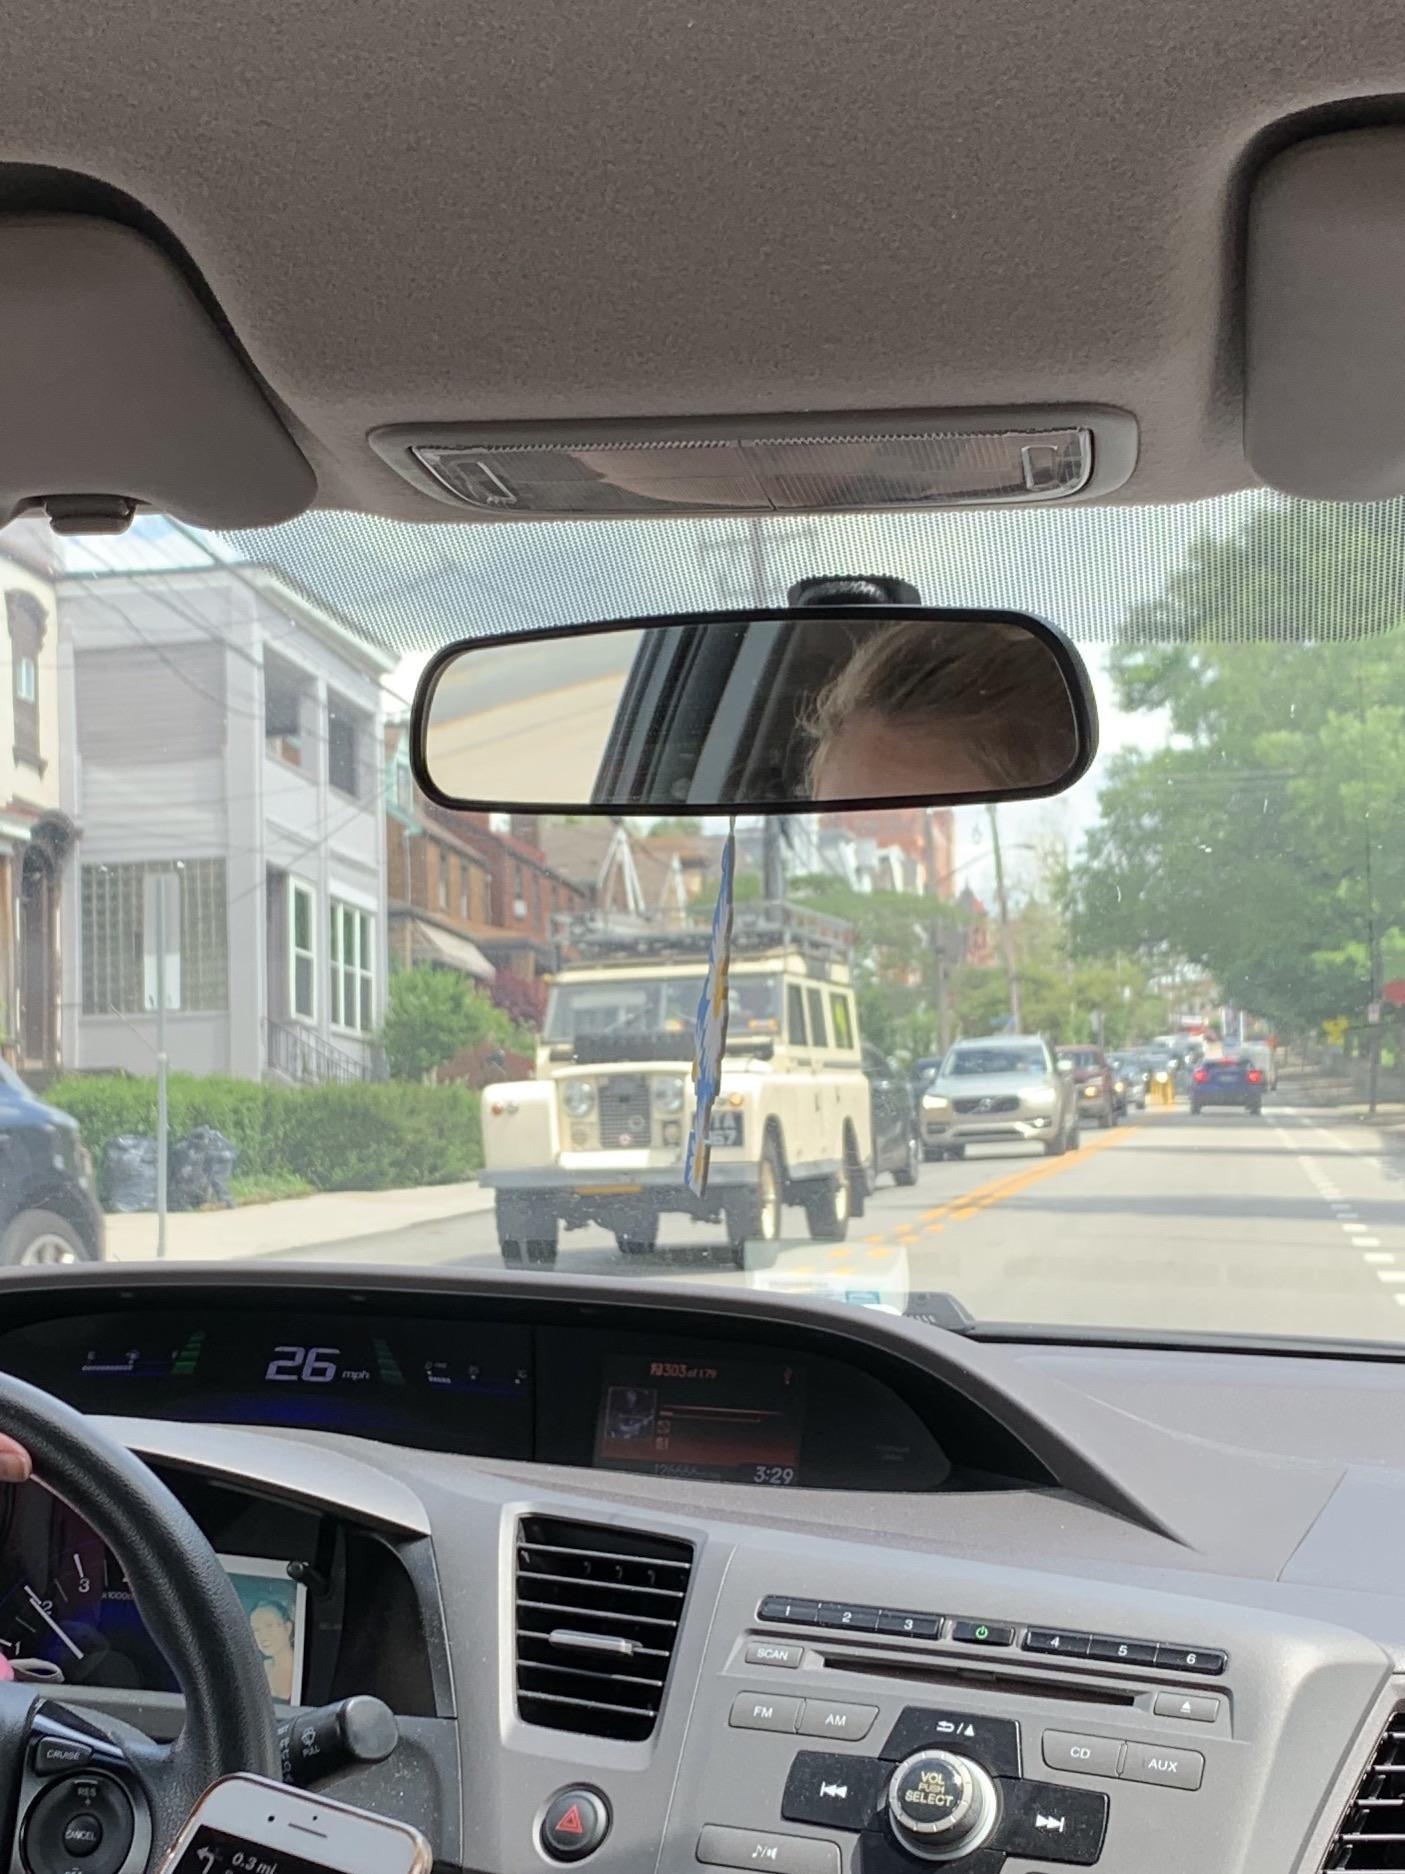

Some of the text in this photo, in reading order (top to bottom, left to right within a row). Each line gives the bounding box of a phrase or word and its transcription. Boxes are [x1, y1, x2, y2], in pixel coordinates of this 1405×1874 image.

[265, 1346, 370, 1382] 26 mph
[754, 1465, 794, 1485] 3:29
[78, 1578, 90, 1593] 3
[785, 1605, 791, 1617] 1
[842, 1611, 852, 1623] 2
[904, 1619, 914, 1631] 3
[15, 1641, 21, 1656] 1
[1050, 1636, 1060, 1648] 4
[757, 1648, 788, 1662] SCAN
[1117, 1644, 1128, 1657] 5
[1186, 1653, 1196, 1665] 6
[753, 1705, 773, 1719] FM
[825, 1713, 847, 1727] AM
[46, 1748, 80, 1761] CRUISE
[1070, 1746, 1091, 1760] CD
[1148, 1758, 1178, 1773] AUX
[921, 1771, 945, 1785] VOL
[918, 1782, 945, 1794] PUSH
[905, 1789, 954, 1807] SELECT
[64, 1829, 97, 1841] CANCEL
[231, 1851, 258, 1871] 0.3
